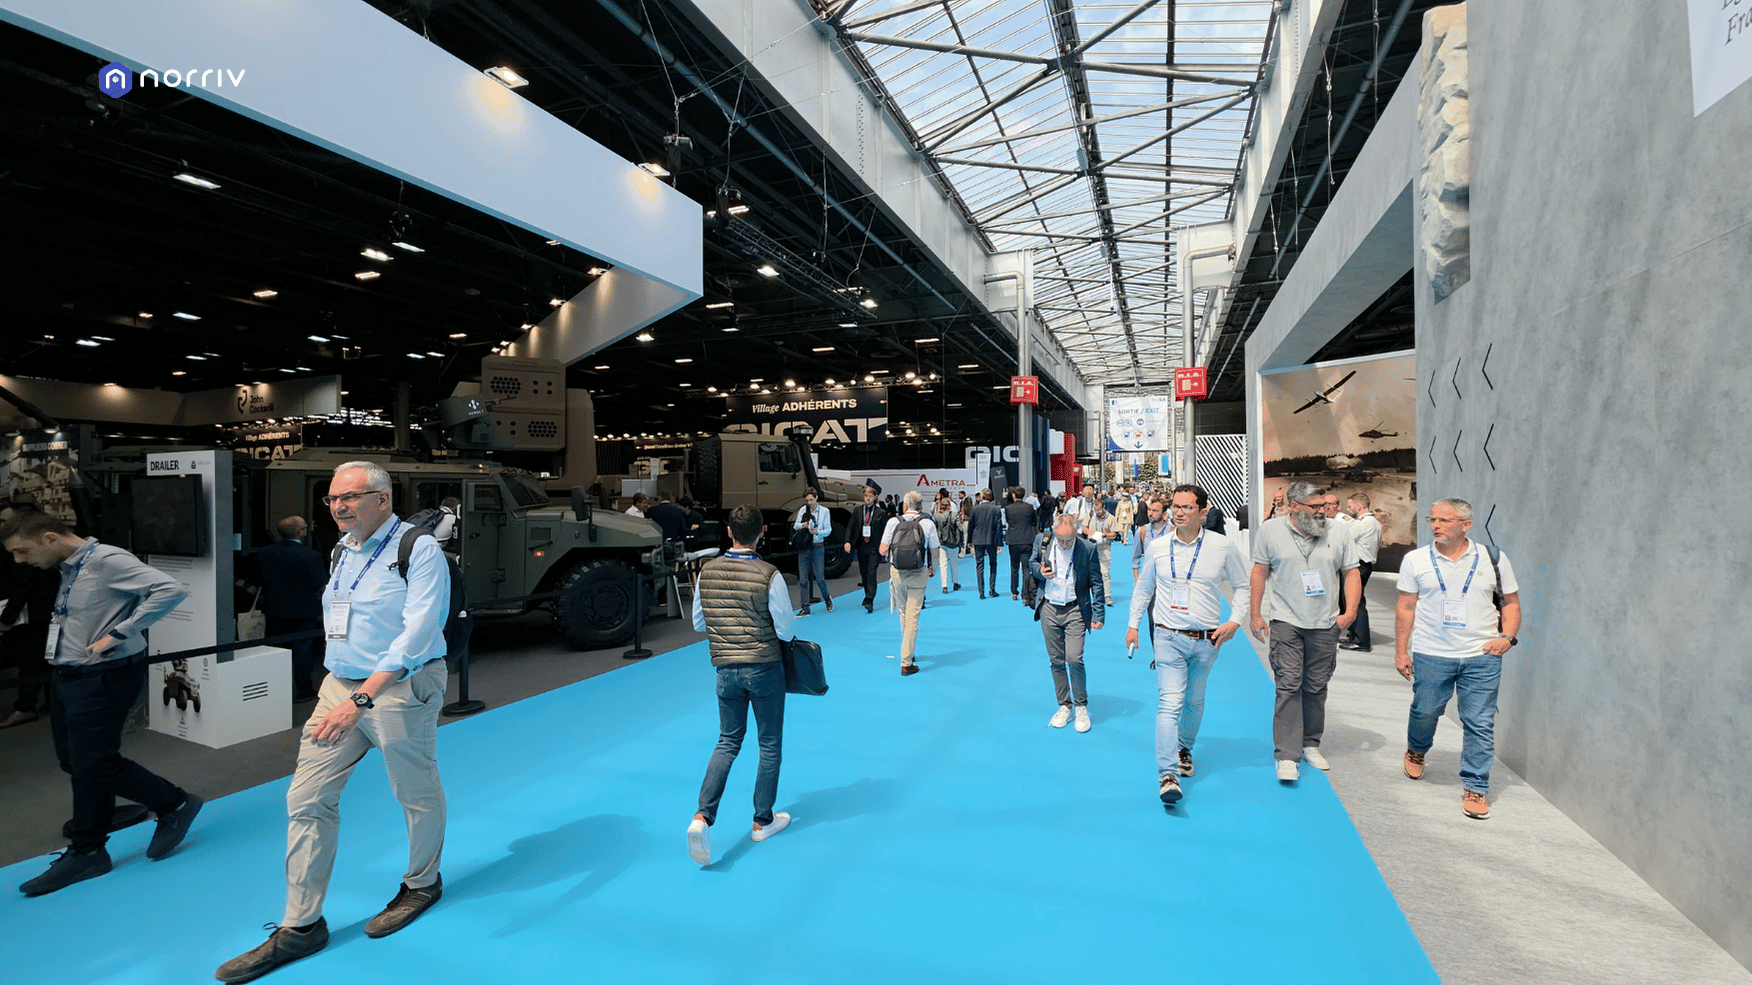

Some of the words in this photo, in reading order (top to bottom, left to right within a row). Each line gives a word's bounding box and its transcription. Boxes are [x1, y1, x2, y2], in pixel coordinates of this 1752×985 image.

[250, 395, 264, 404] John
[250, 403, 275, 414] Cockerill
[752, 404, 780, 415] Village
[782, 399, 858, 412] ADHÉRENTS
[150, 460, 180, 471] DRAILER
[917, 473, 966, 487] AMETRA
